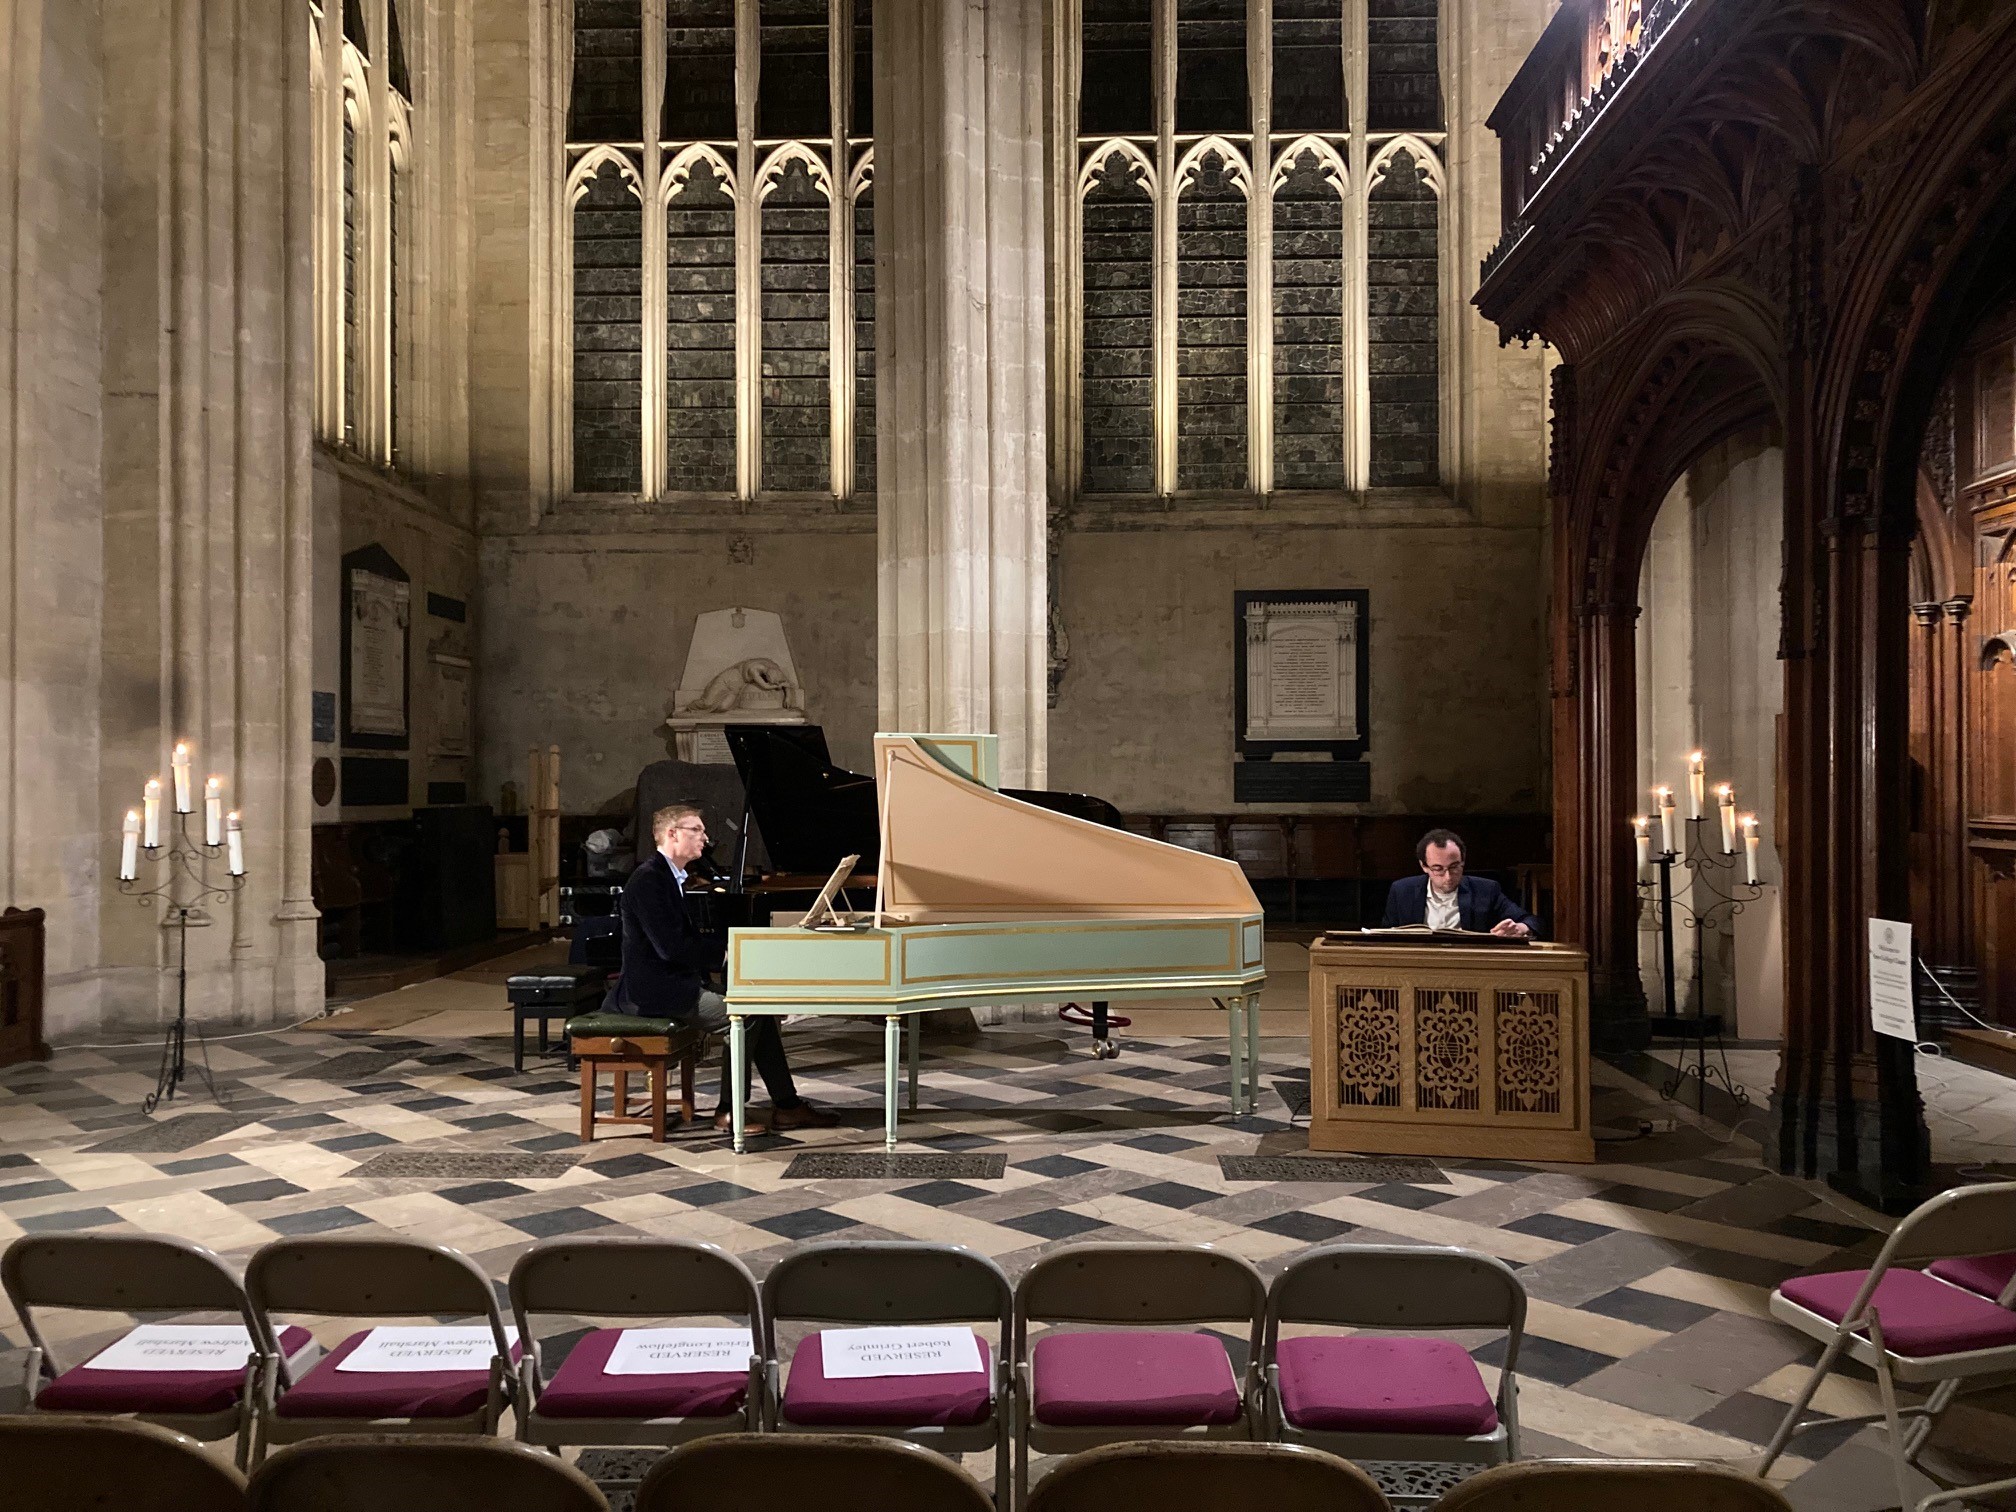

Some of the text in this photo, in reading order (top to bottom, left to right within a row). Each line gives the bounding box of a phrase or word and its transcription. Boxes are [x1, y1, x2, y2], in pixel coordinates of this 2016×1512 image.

[134, 1339, 249, 1347] Andrew Marshall
[379, 1339, 494, 1348] Andrew Marshall
[636, 1341, 711, 1350] Longfellow
[848, 1340, 951, 1352] Robert Grimley
[389, 1349, 472, 1357] RESERVED
[650, 1350, 730, 1359] RESERVED
[861, 1351, 941, 1362] RESERVED
